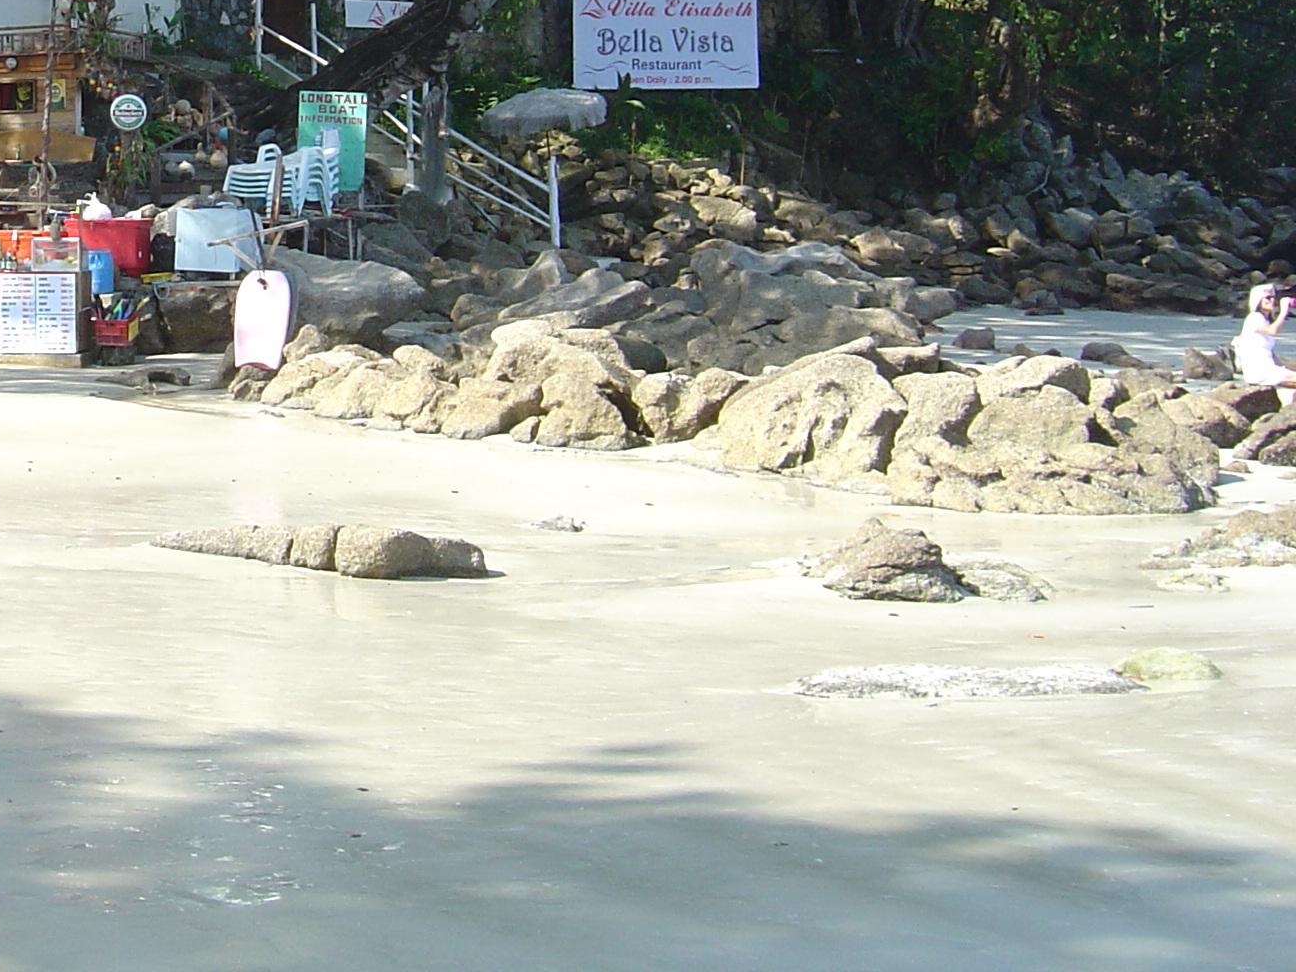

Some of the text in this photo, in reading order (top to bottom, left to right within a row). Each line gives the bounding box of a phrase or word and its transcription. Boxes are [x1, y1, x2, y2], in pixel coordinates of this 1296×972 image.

[596, 27, 735, 55] Bella Vista
[631, 58, 702, 71] Restaurant
[646, 75, 667, 85] Daily
[318, 105, 358, 115] BOAT
[300, 115, 363, 125] INFORMATION
